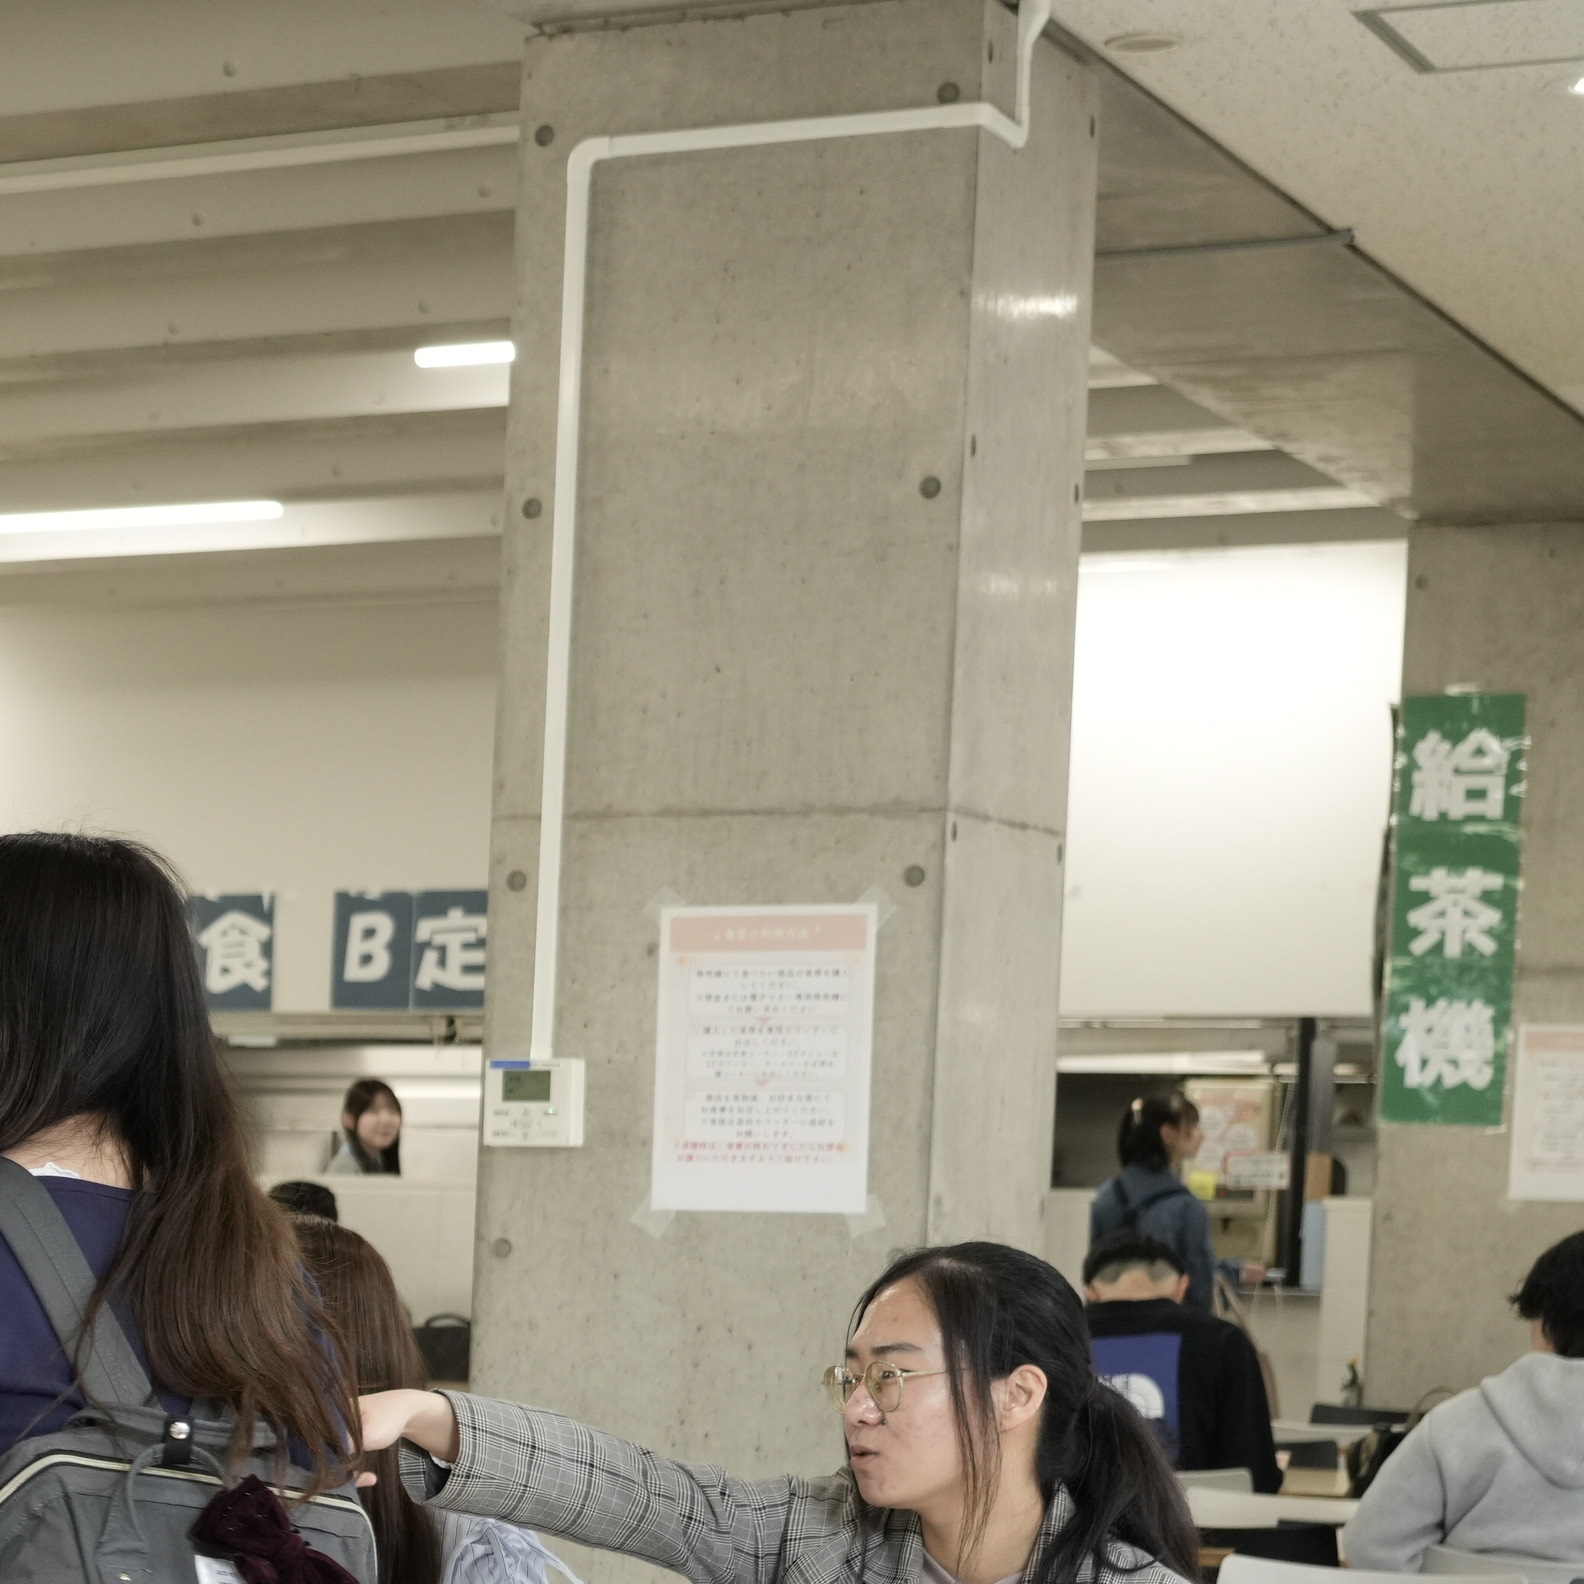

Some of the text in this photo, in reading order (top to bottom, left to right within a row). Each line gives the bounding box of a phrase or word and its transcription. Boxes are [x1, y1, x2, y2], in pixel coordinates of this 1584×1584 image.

[198, 910, 270, 994] 食
[1396, 727, 1512, 1091] 給茶機
